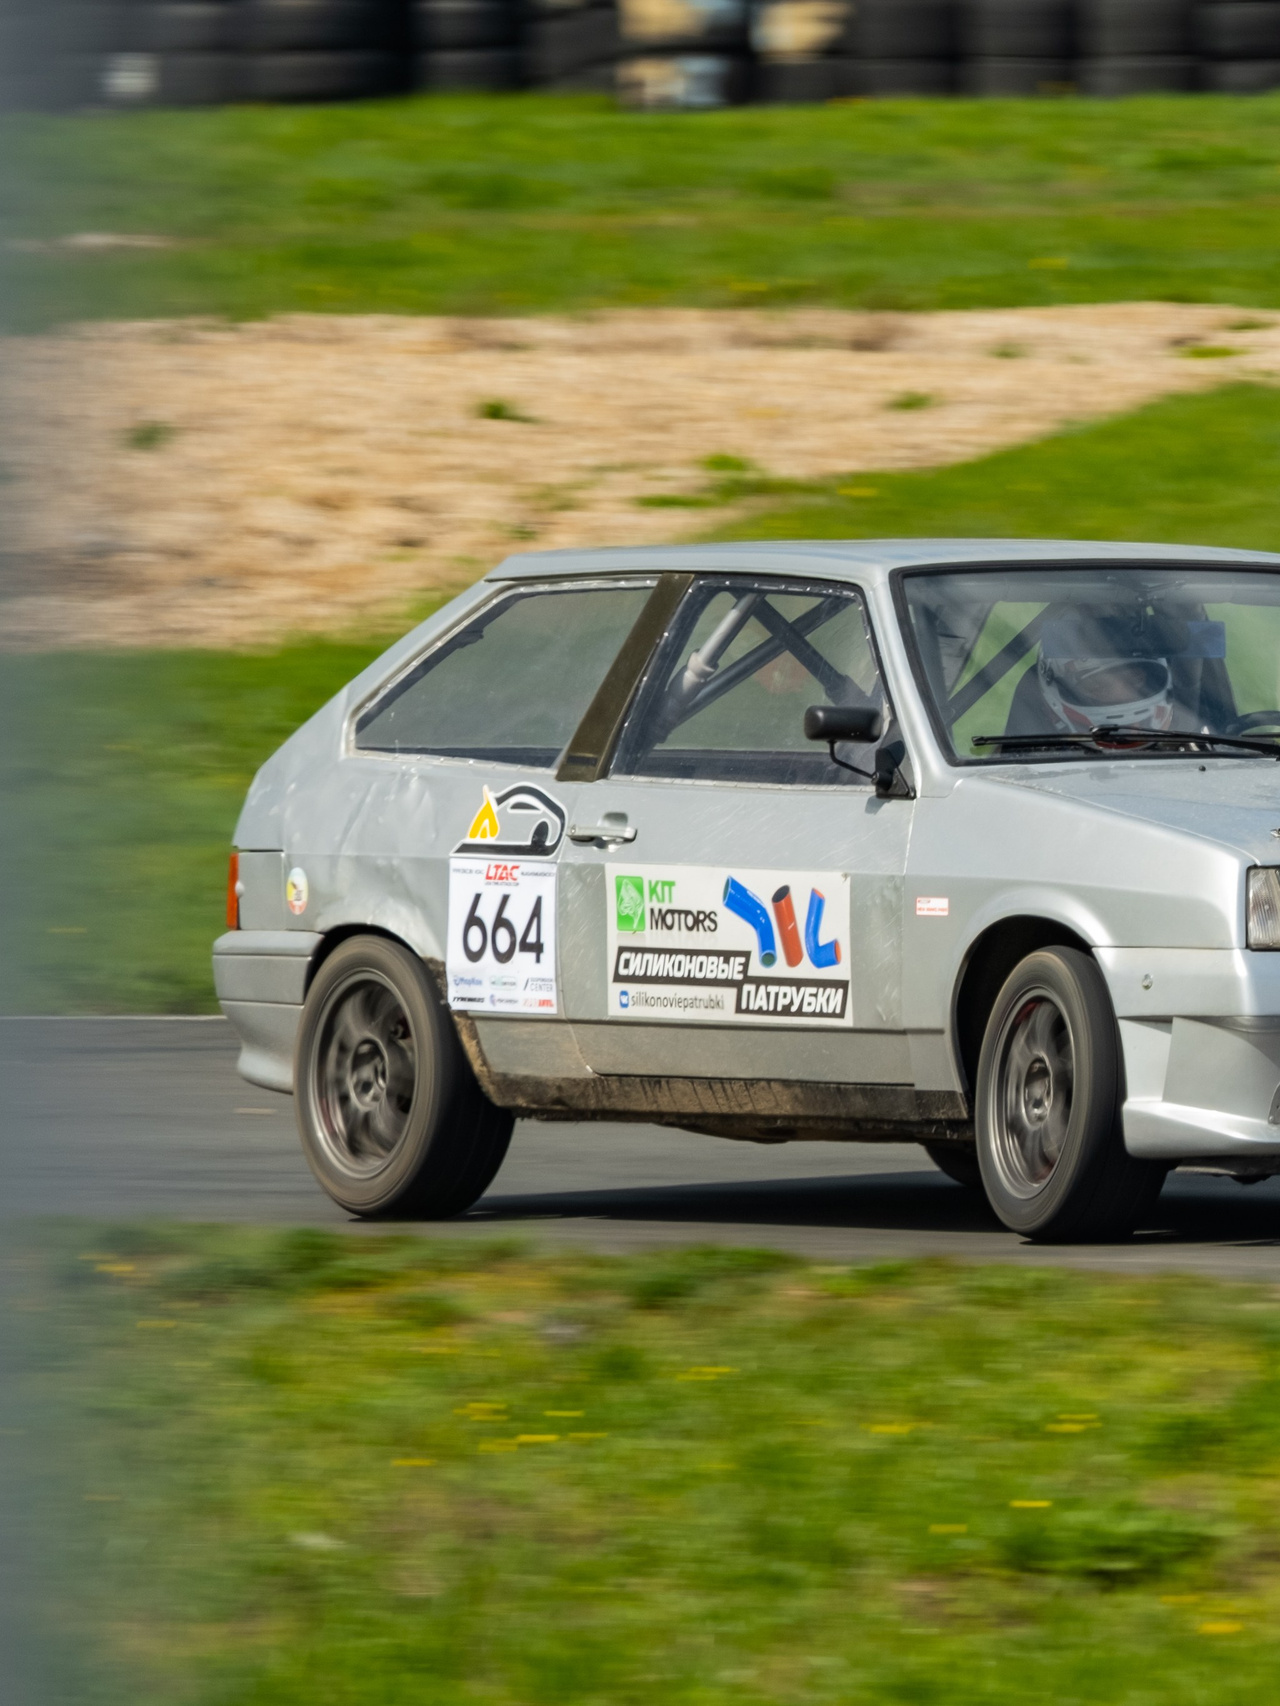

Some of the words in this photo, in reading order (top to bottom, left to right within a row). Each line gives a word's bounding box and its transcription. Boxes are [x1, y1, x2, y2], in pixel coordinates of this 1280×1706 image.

[485, 864, 520, 881] LTAC
[649, 880, 676, 904] KIT
[463, 892, 544, 964] 664
[650, 908, 718, 932] MOTORS
[618, 951, 746, 980] СИЛИКОНОВЫЕ
[530, 982, 553, 992] CENTER
[741, 983, 844, 1014] ПАТРУБКИ
[631, 990, 725, 1012] silikonoviepatrubki
